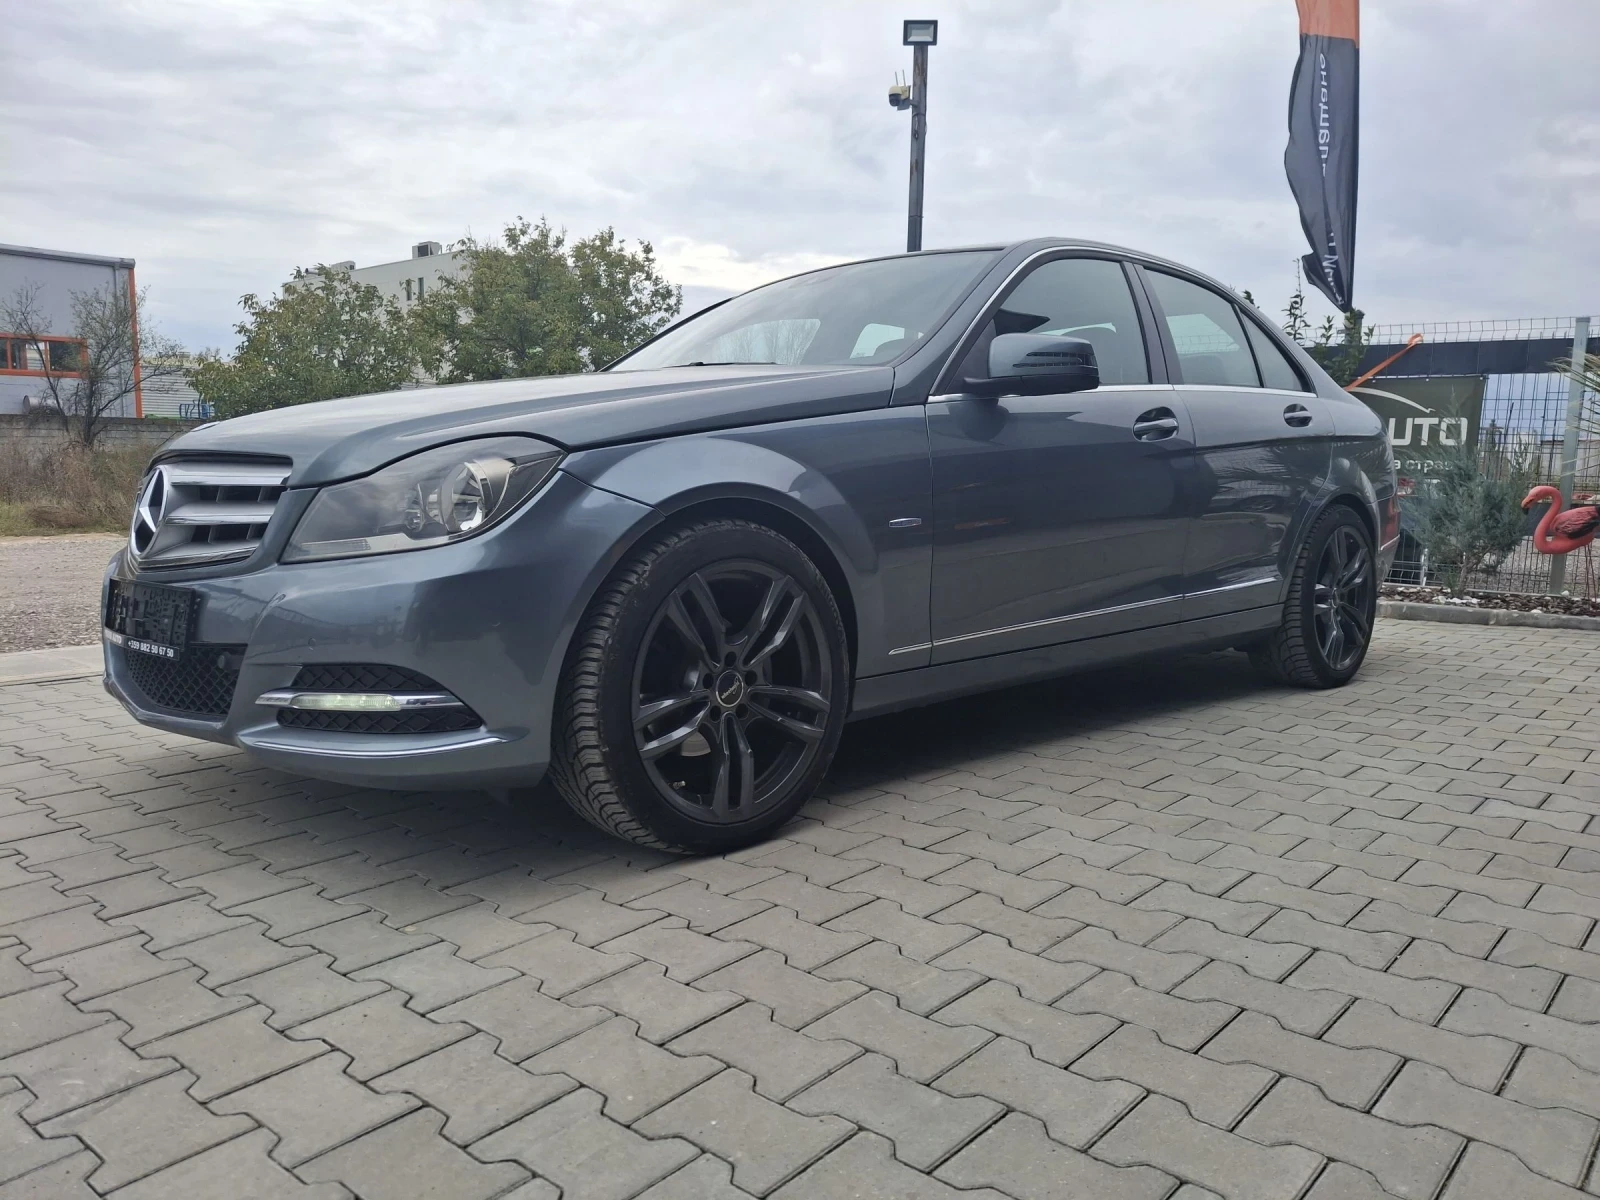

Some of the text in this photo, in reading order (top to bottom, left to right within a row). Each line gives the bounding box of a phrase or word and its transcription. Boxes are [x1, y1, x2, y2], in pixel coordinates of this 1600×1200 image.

[1388, 417, 1468, 446] UTO
[151, 645, 158, 653] 50
[167, 648, 174, 657] 50
